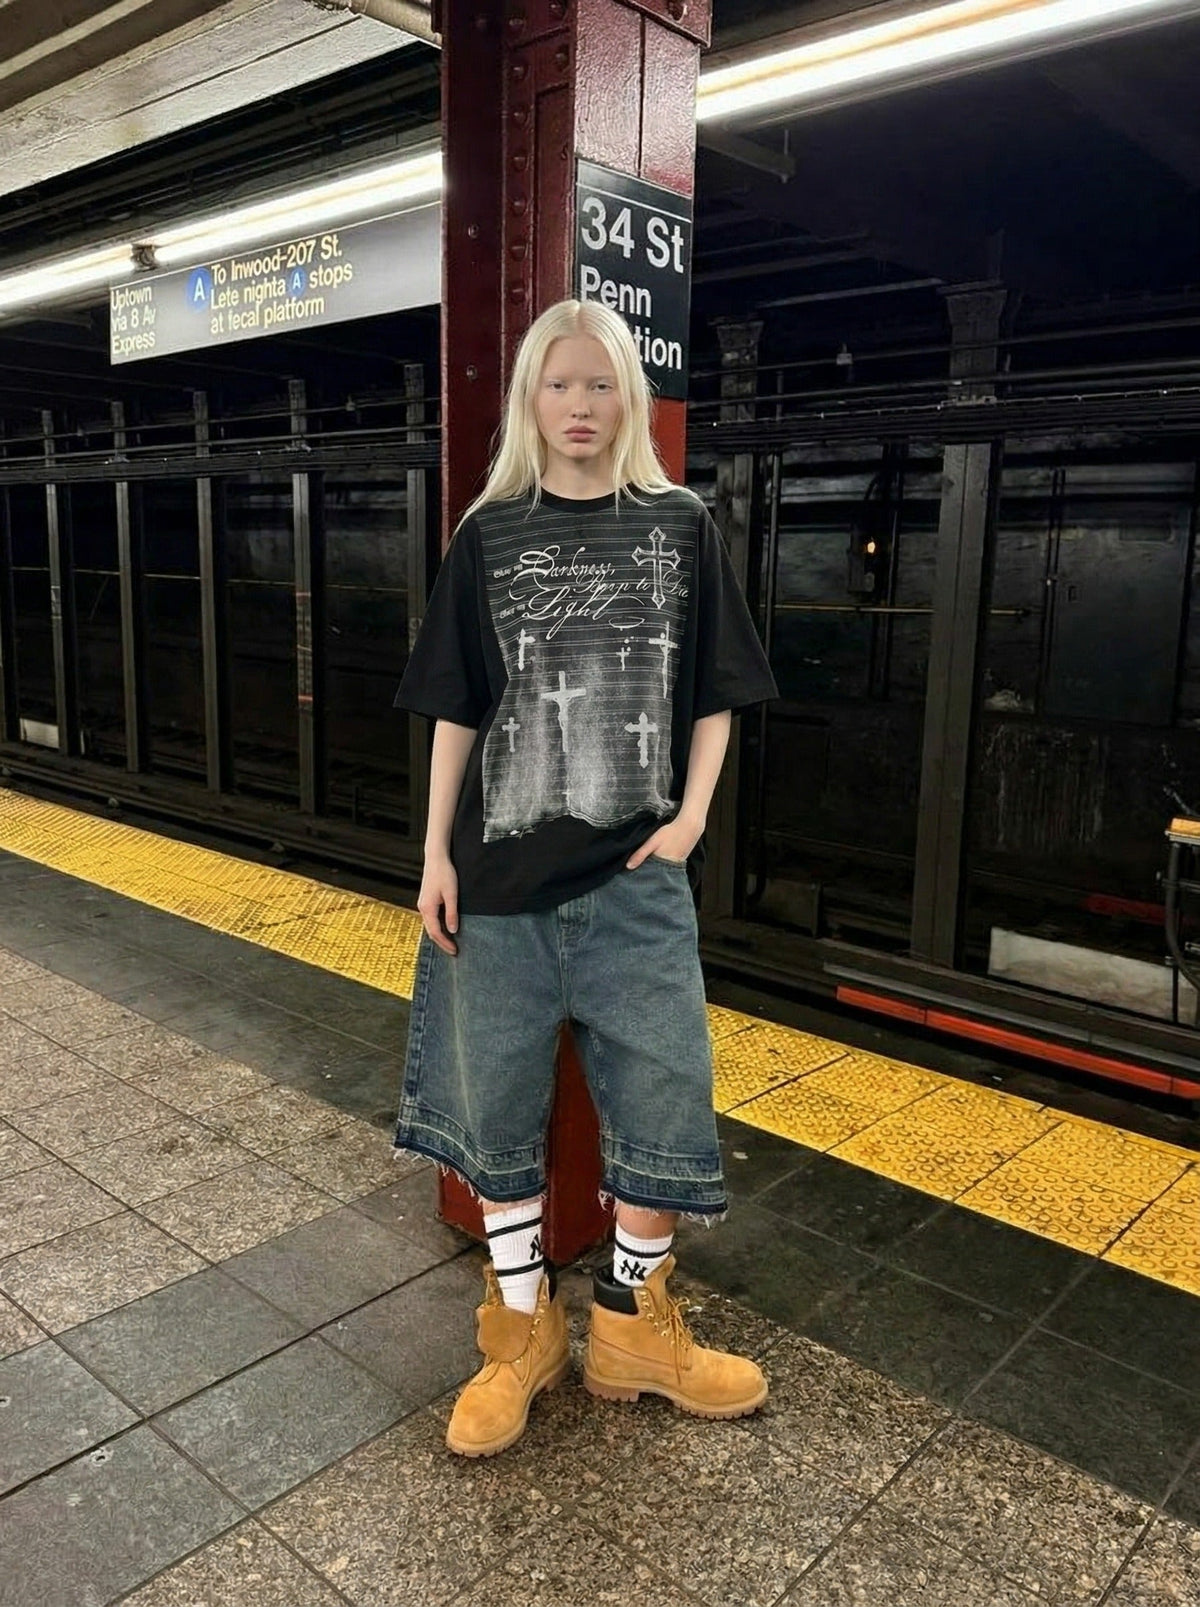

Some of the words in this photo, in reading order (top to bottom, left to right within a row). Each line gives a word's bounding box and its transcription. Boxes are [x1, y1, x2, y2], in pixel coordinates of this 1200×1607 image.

[581, 197, 635, 259] 34
[646, 215, 684, 274] St
[211, 264, 226, 285] To
[231, 239, 317, 281] Inwood-207
[320, 234, 342, 260] St.
[292, 272, 301, 290] A
[309, 263, 353, 289] stops
[193, 277, 206, 302] A
[580, 263, 651, 318] Penn
[131, 307, 139, 328] 8
[210, 312, 224, 334] at
[264, 296, 325, 328] platform
[112, 331, 156, 356] Express
[633, 324, 683, 370] tion
